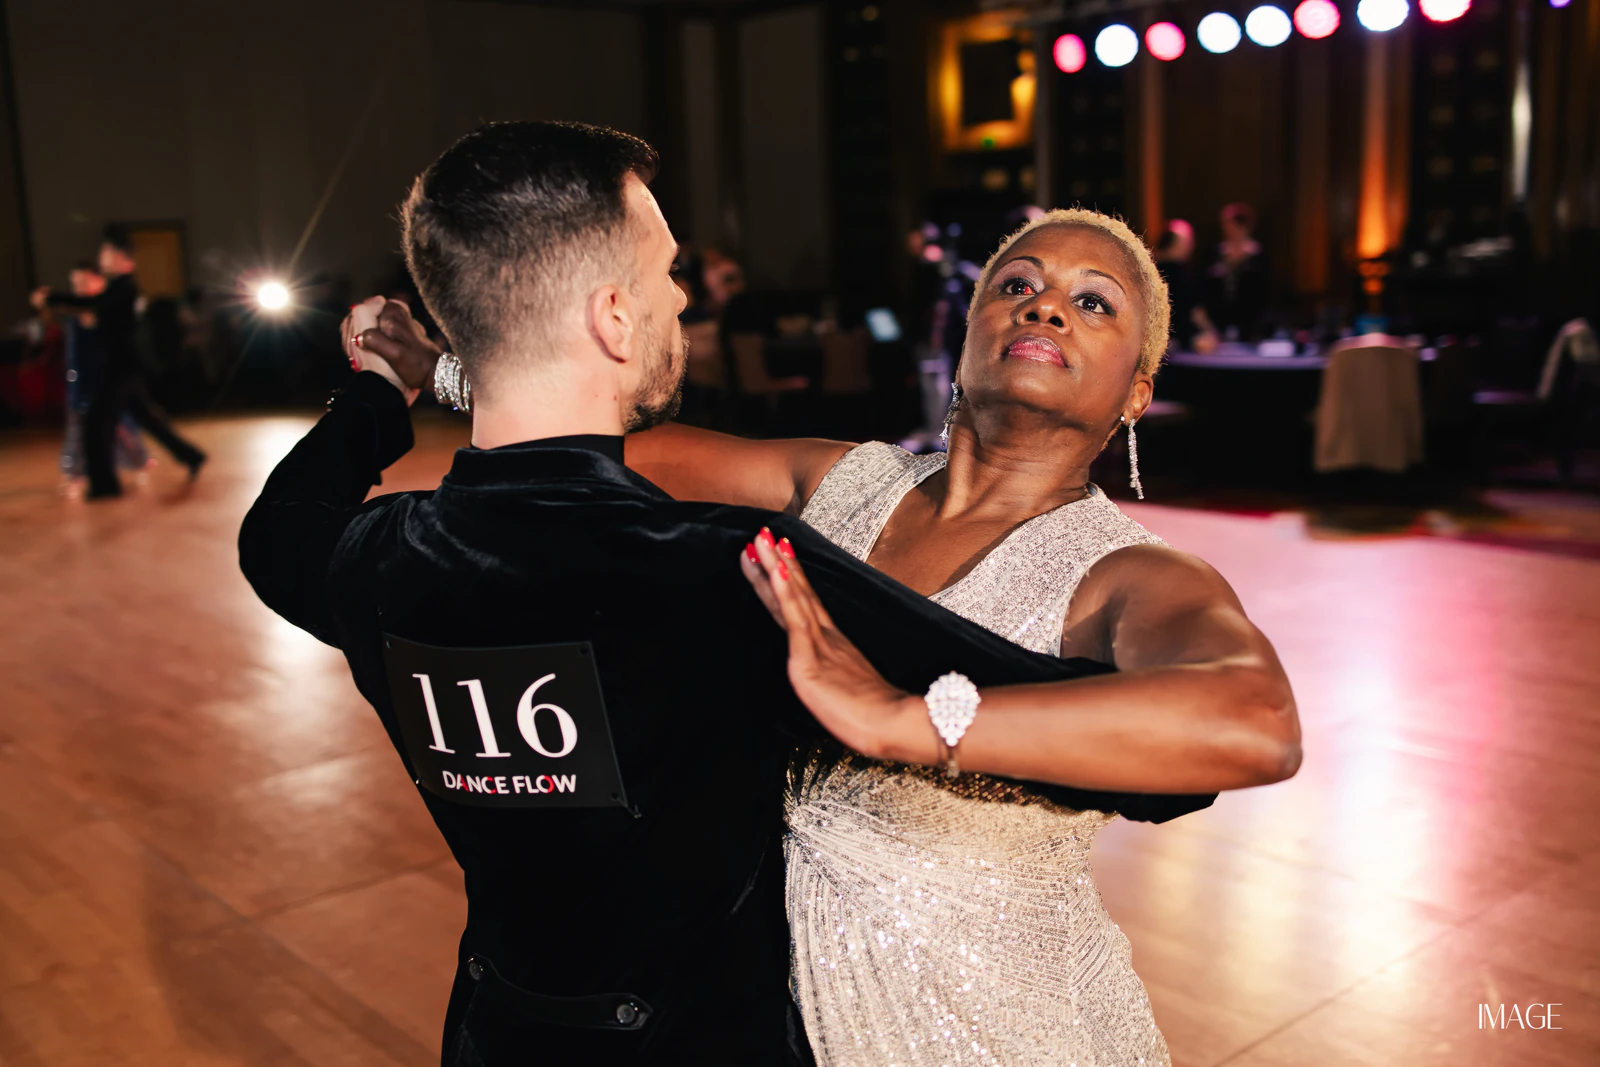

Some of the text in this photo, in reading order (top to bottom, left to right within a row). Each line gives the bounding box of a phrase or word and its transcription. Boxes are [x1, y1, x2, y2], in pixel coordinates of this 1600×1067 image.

[412, 673, 578, 758] 116
[442, 770, 577, 794] DANCE FLOW
